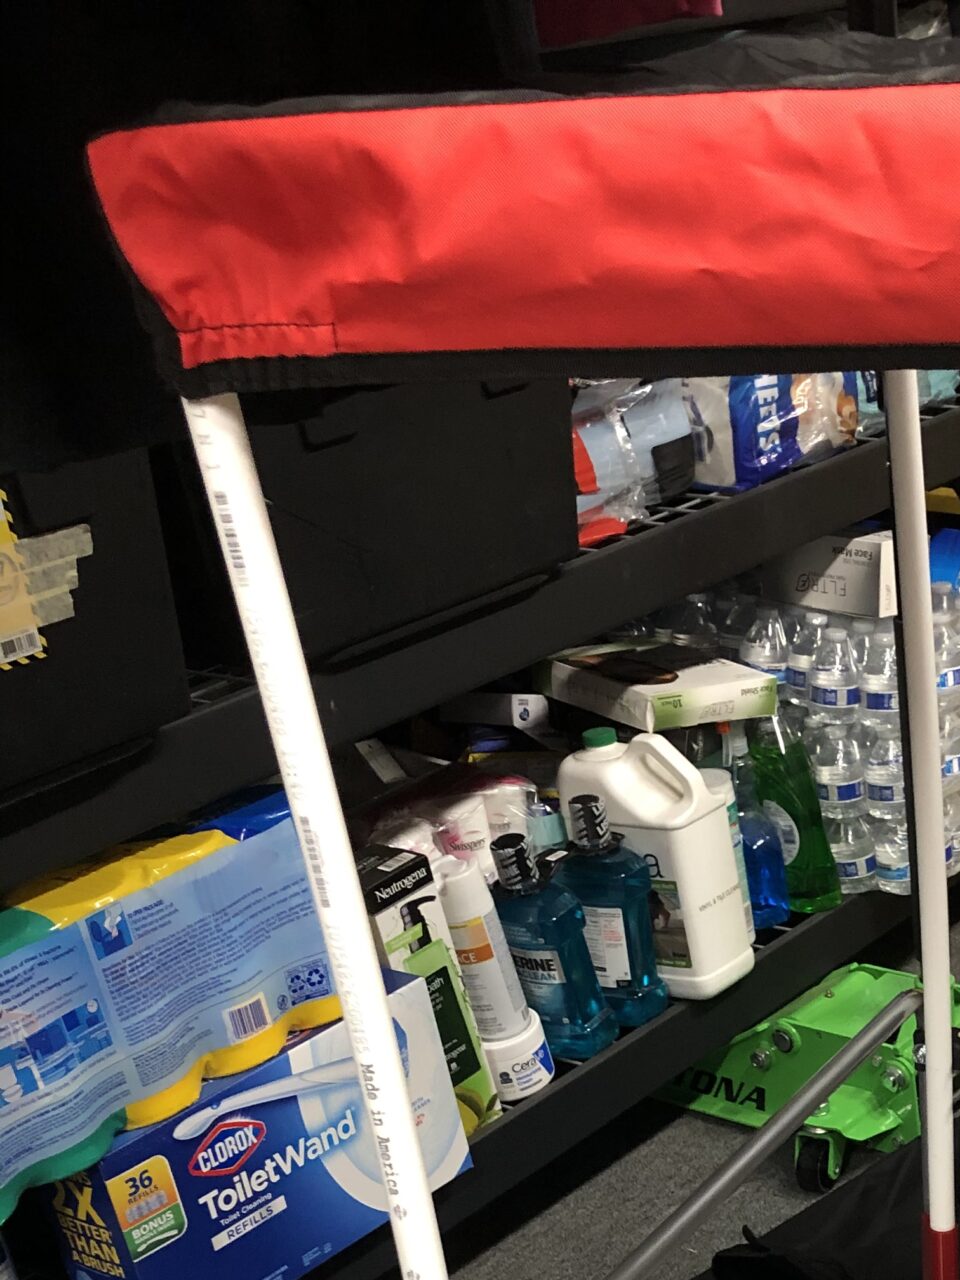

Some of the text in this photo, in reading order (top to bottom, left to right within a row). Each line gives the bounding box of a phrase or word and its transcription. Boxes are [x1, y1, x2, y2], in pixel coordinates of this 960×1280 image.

[853, 549, 873, 560] Face
[673, 699, 683, 709] 10
[374, 867, 427, 902] Neutrogena
[360, 1062, 380, 1101] Made
[371, 1110, 383, 1126] in
[377, 1136, 399, 1196] America
[198, 1124, 259, 1173] CLOROX
[198, 1108, 357, 1220] ToiletWand
[125, 1169, 153, 1197] 36
[128, 1184, 160, 1205] REFILLS
[131, 1210, 174, 1239] BONUS
[220, 1192, 273, 1227] Toilet Cleaning
[226, 1206, 274, 1240] REFILLS
[62, 1229, 120, 1265] THAN
[81, 1254, 125, 1279] BRUSH
